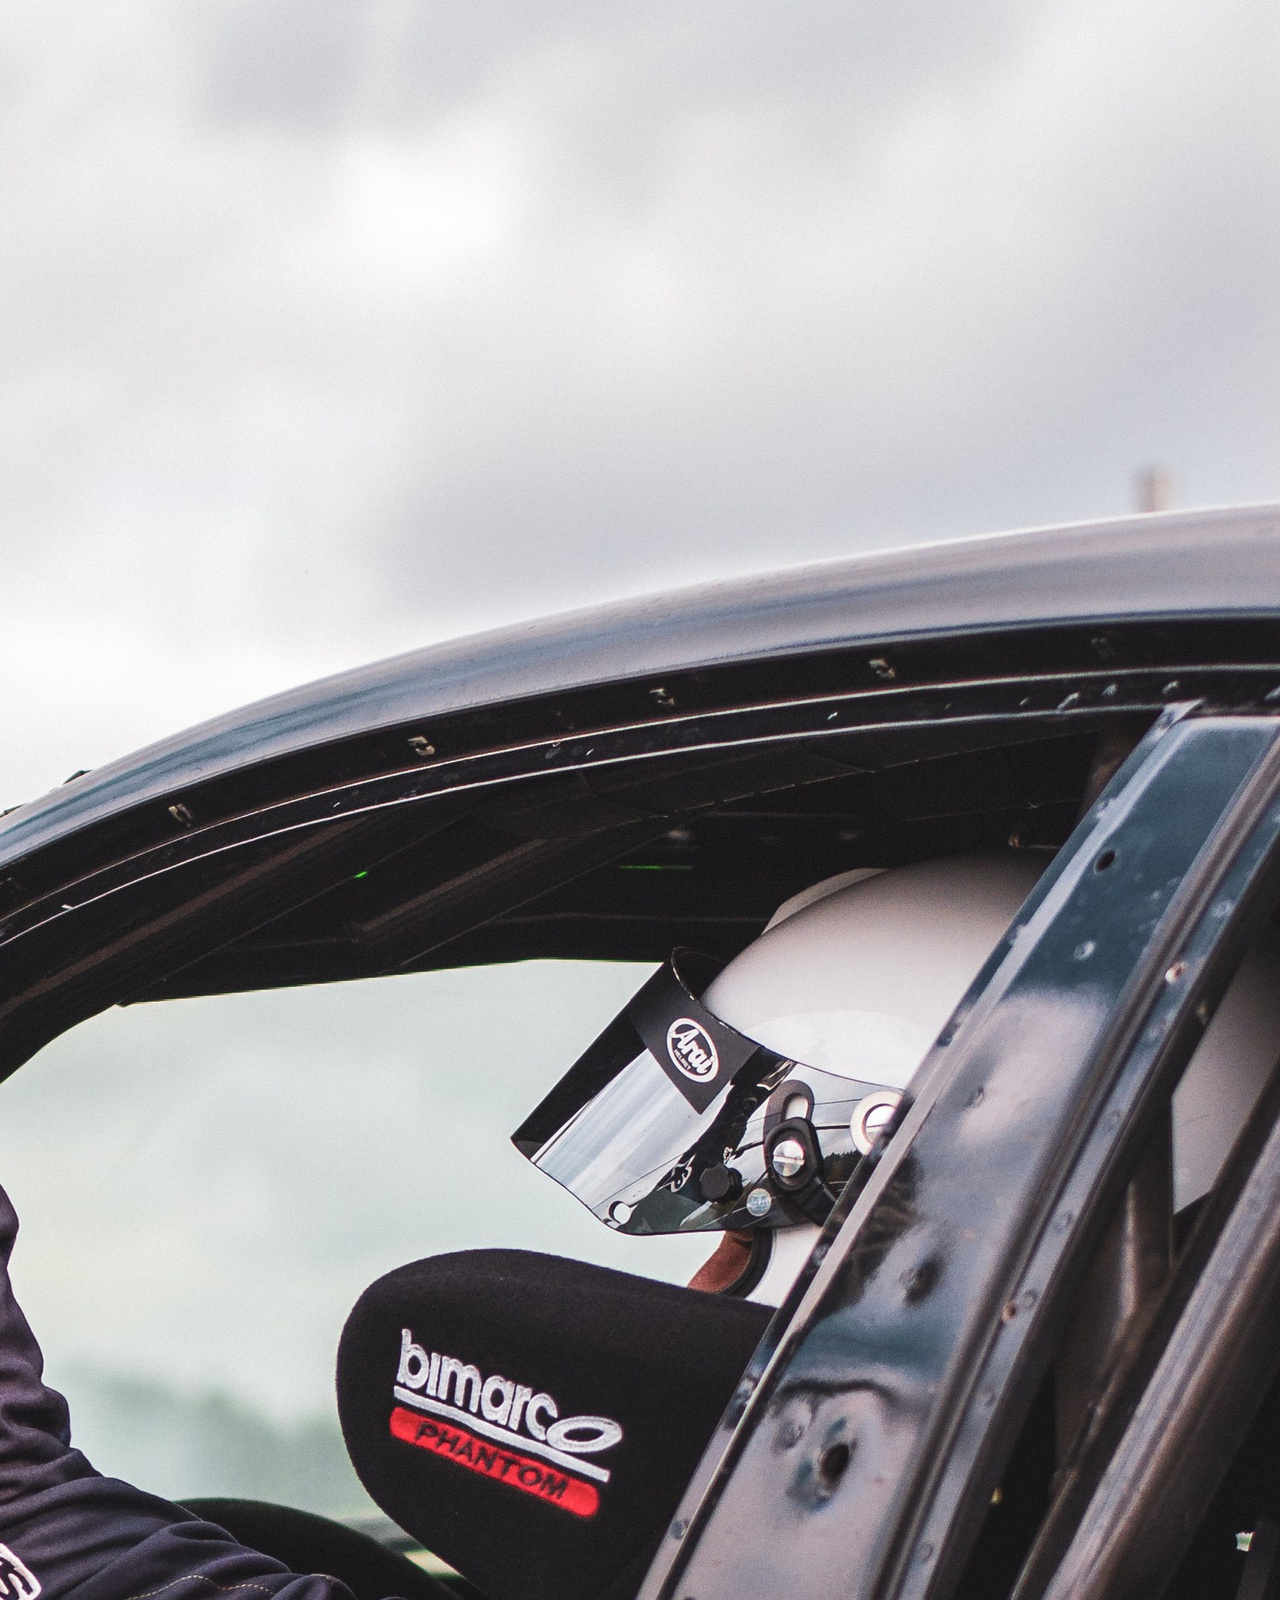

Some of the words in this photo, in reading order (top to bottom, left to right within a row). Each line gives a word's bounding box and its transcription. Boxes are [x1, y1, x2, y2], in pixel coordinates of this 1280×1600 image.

[669, 1028, 716, 1074] Arai
[396, 1328, 623, 1453] bimarco
[415, 1421, 569, 1501] PHANTOM
